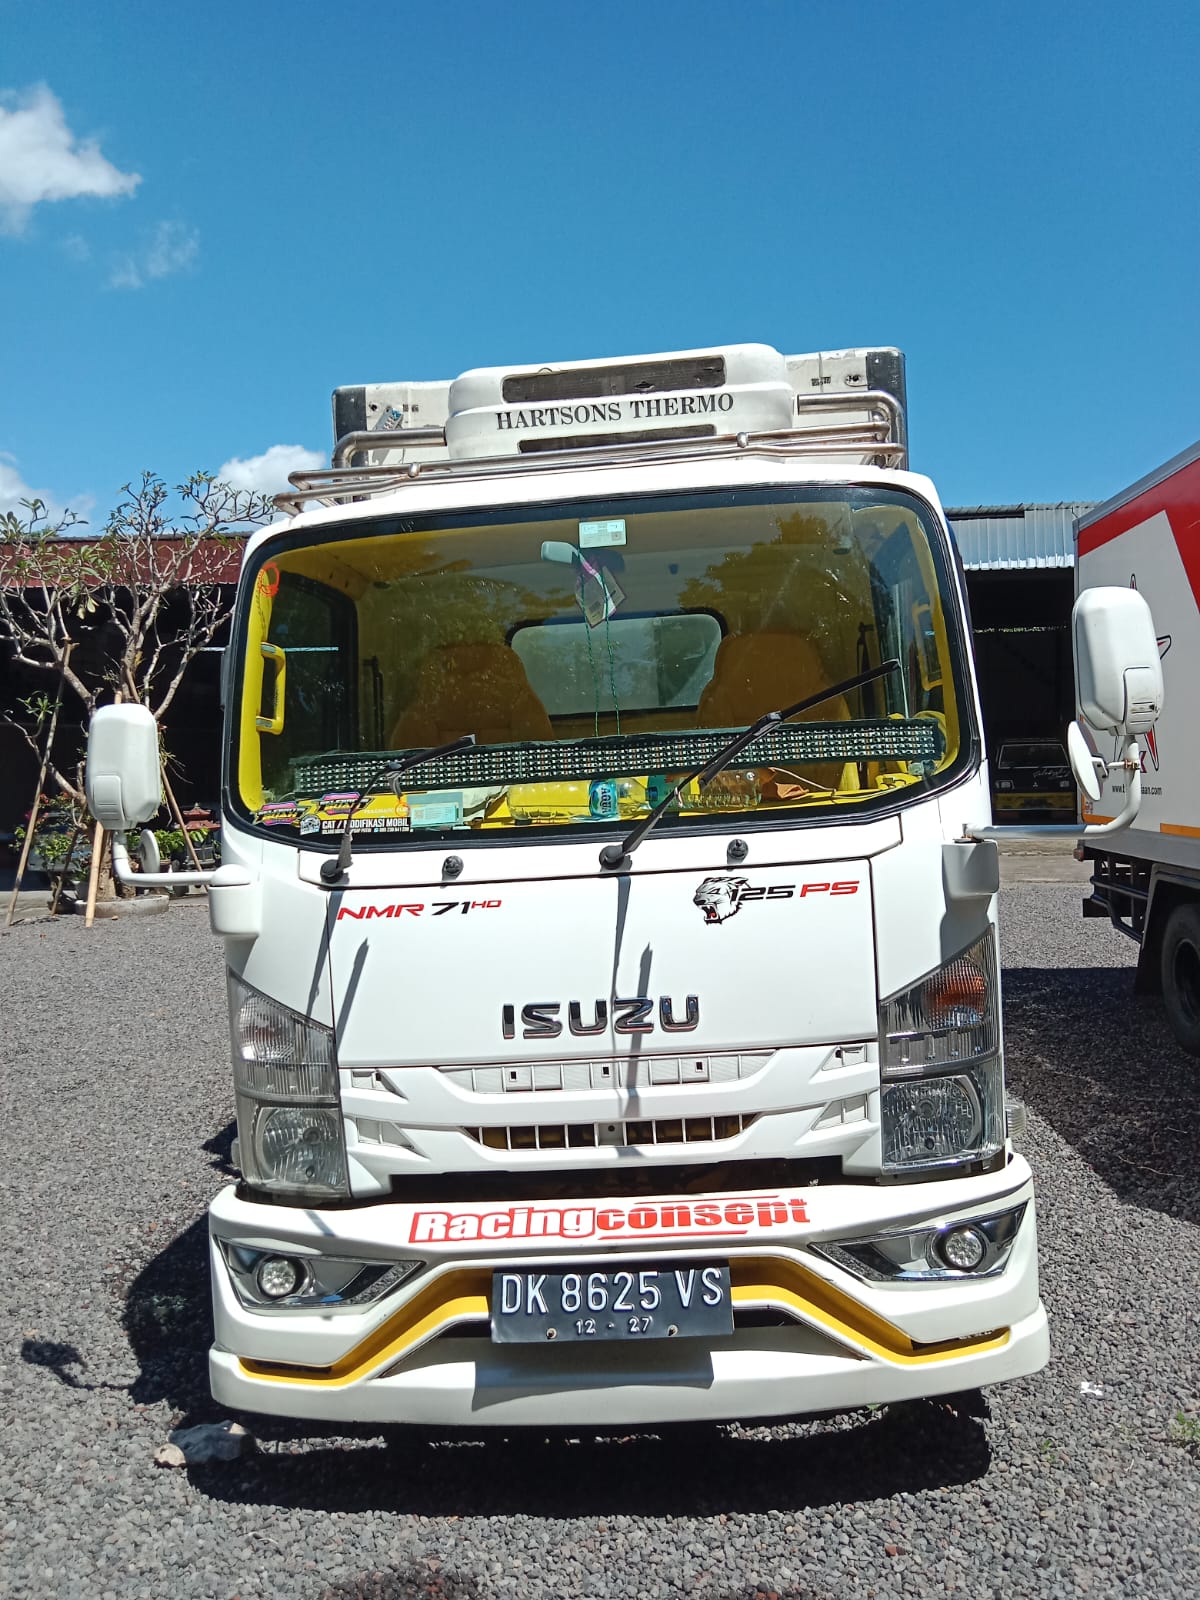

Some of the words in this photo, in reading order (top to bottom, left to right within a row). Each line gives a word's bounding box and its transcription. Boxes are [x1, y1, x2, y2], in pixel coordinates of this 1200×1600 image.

[496, 402, 622, 431] HARTSONS
[630, 391, 734, 420] THERMO
[600, 788, 612, 813] AQUA
[322, 820, 336, 829] CAT
[386, 818, 409, 827] MOBIL
[729, 884, 796, 902] 125
[799, 880, 860, 897] PS
[336, 902, 424, 920] NMR
[502, 993, 699, 1040] ISUZU
[501, 1273, 548, 1315] DK
[560, 1271, 662, 1313] 8625
[674, 1267, 723, 1309] VS
[575, 1318, 597, 1335] 12
[628, 1316, 653, 1334] 27
